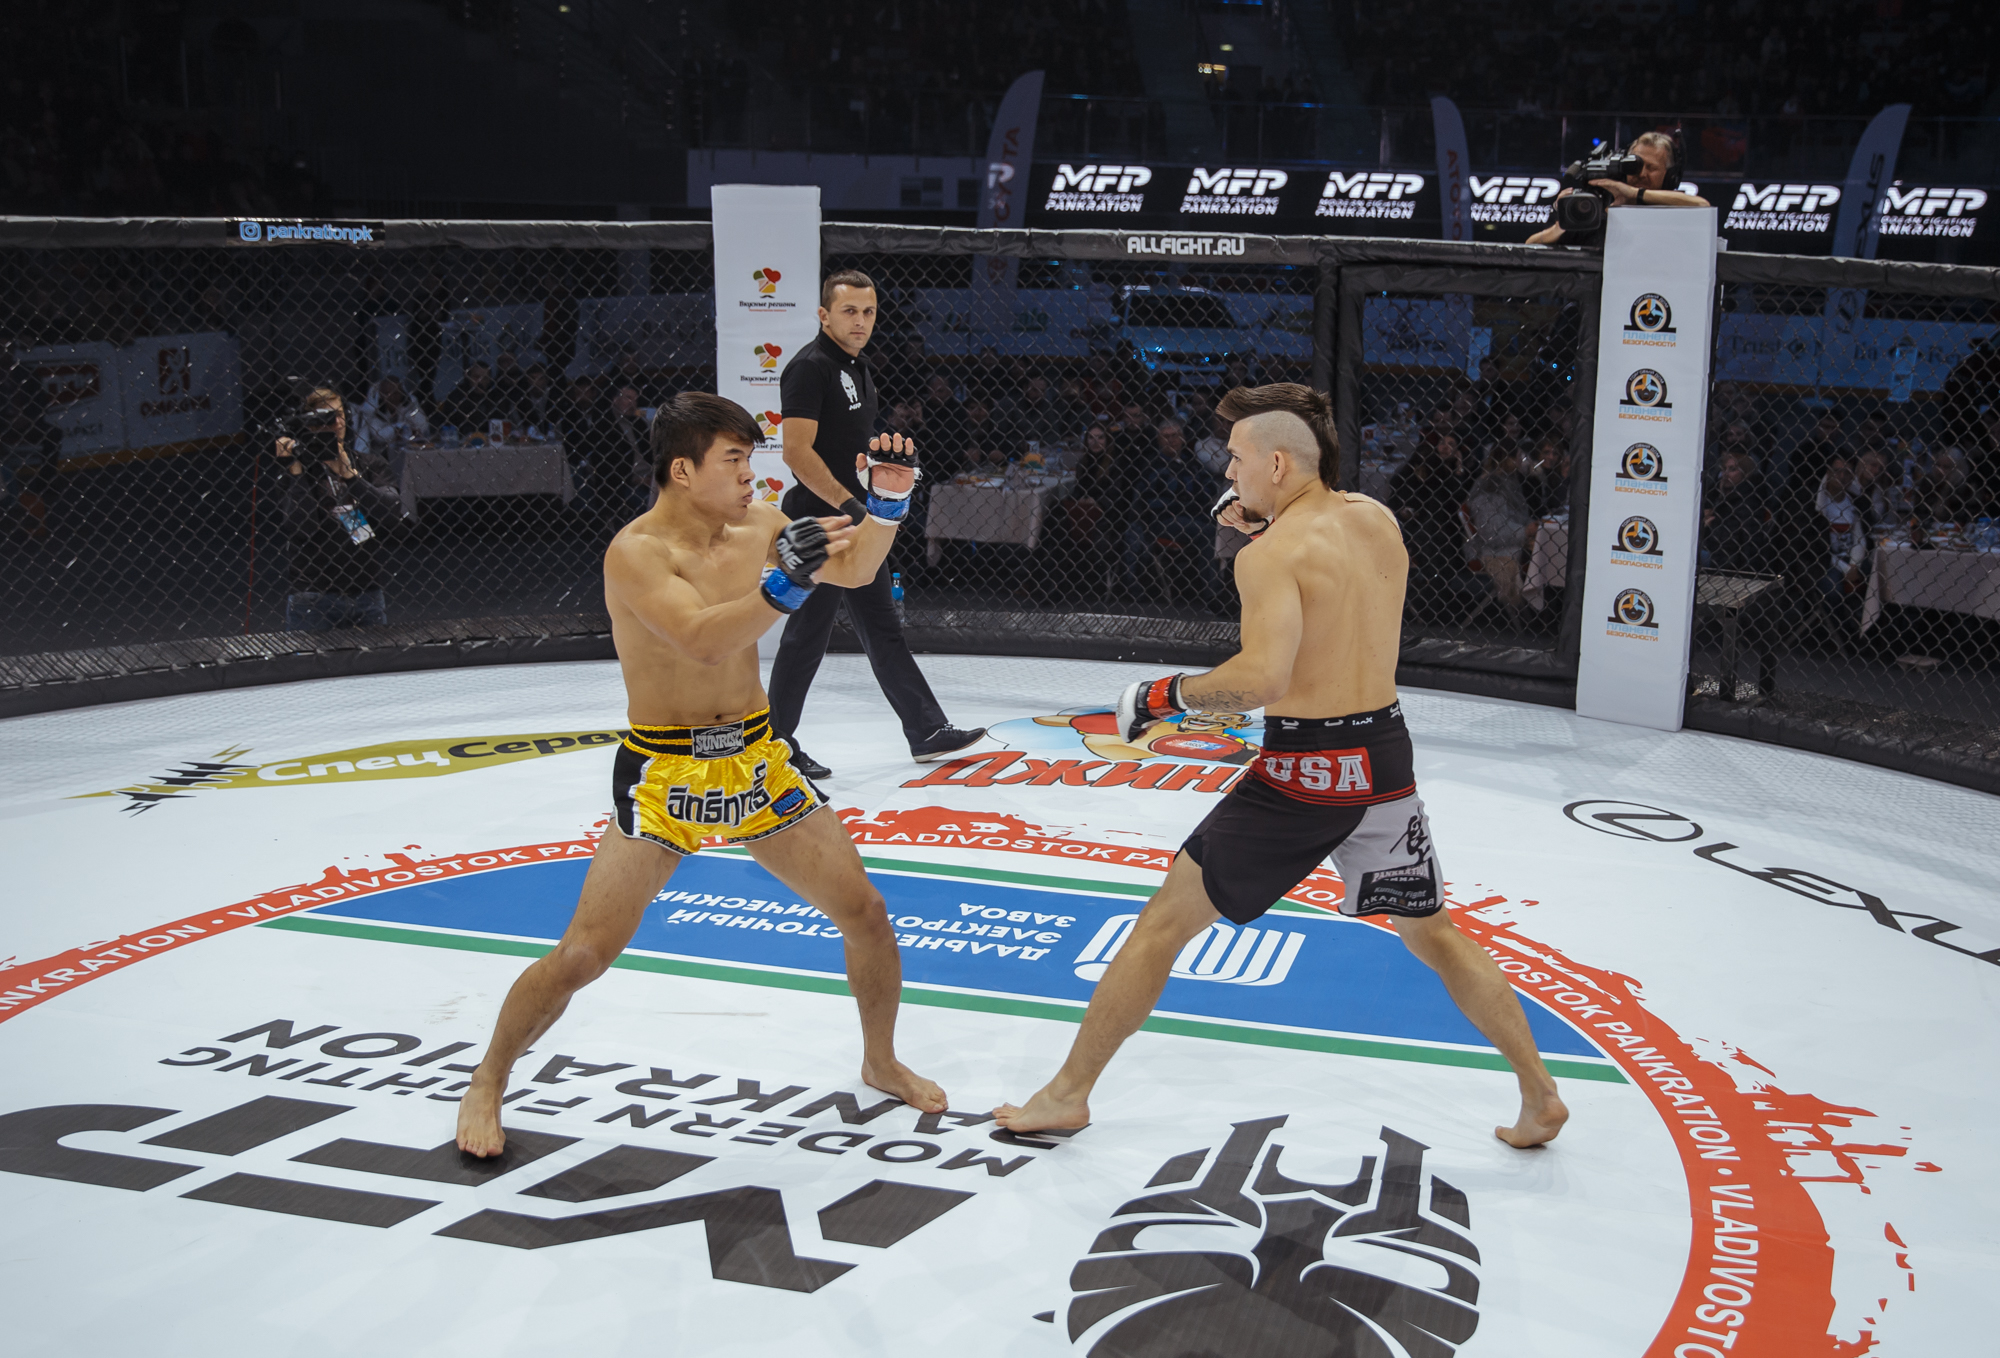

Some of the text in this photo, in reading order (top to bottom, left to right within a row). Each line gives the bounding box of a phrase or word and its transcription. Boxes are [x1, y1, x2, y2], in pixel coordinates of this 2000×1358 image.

[1052, 164, 1152, 193] MFP
[1187, 167, 1288, 196] MFP
[1322, 171, 1425, 200] MFP
[1045, 200, 1142, 212] PANKRATION
[1180, 202, 1277, 215] PANKRATION
[1732, 183, 1841, 212] MFP
[1879, 187, 1988, 216] MFP
[1315, 206, 1414, 219] PANKRATION
[1470, 210, 1549, 223] NKRATION
[1724, 218, 1829, 232] PANKRATION
[1881, 215, 1922, 225] ODERN
[267, 223, 373, 244] pankrationpk
[1879, 223, 1974, 237] ANKRATION
[1127, 236, 1245, 255] ALLFIGHT.RU
[739, 300, 796, 309] Вкусные регионы
[1622, 339, 1676, 348] БЕЗОПАСНОСТИ
[740, 375, 768, 383] Вкусные
[1618, 412, 1672, 422] БЕЗОПАСНОСТИ
[1615, 486, 1668, 496] БЕЗОПАСНОСТИ
[775, 537, 804, 570] ONE
[1610, 558, 1663, 570] БЕЗОПАСНОСТИ
[1606, 629, 1659, 642] БЕЗОПАСНОСТИ
[695, 729, 743, 753] SUNRISE
[257, 730, 632, 781] СпецСерв
[899, 751, 1249, 794] Джин
[1263, 755, 1370, 792] USA
[773, 788, 806, 816] SUNRISE
[848, 831, 1117, 860] VLADIVOSTOK
[226, 848, 532, 919] VLADIVOSTOK
[1370, 861, 1430, 884] PANKRATION
[1362, 895, 1435, 907] АКАДМИЯ
[1405, 889, 1427, 899] Fight
[1693, 842, 2000, 966] LEXU
[959, 902, 1077, 928] ЗАВОД
[0, 924, 207, 1010] NKRATION
[1483, 946, 1614, 1020] VOSTOK
[1593, 1018, 1741, 1162] PANKRATION
[158, 1046, 1037, 1178] MODERN FIGHTING
[0, 1094, 978, 1294] MFP
[1673, 1180, 1760, 1358] VLADIVOST
